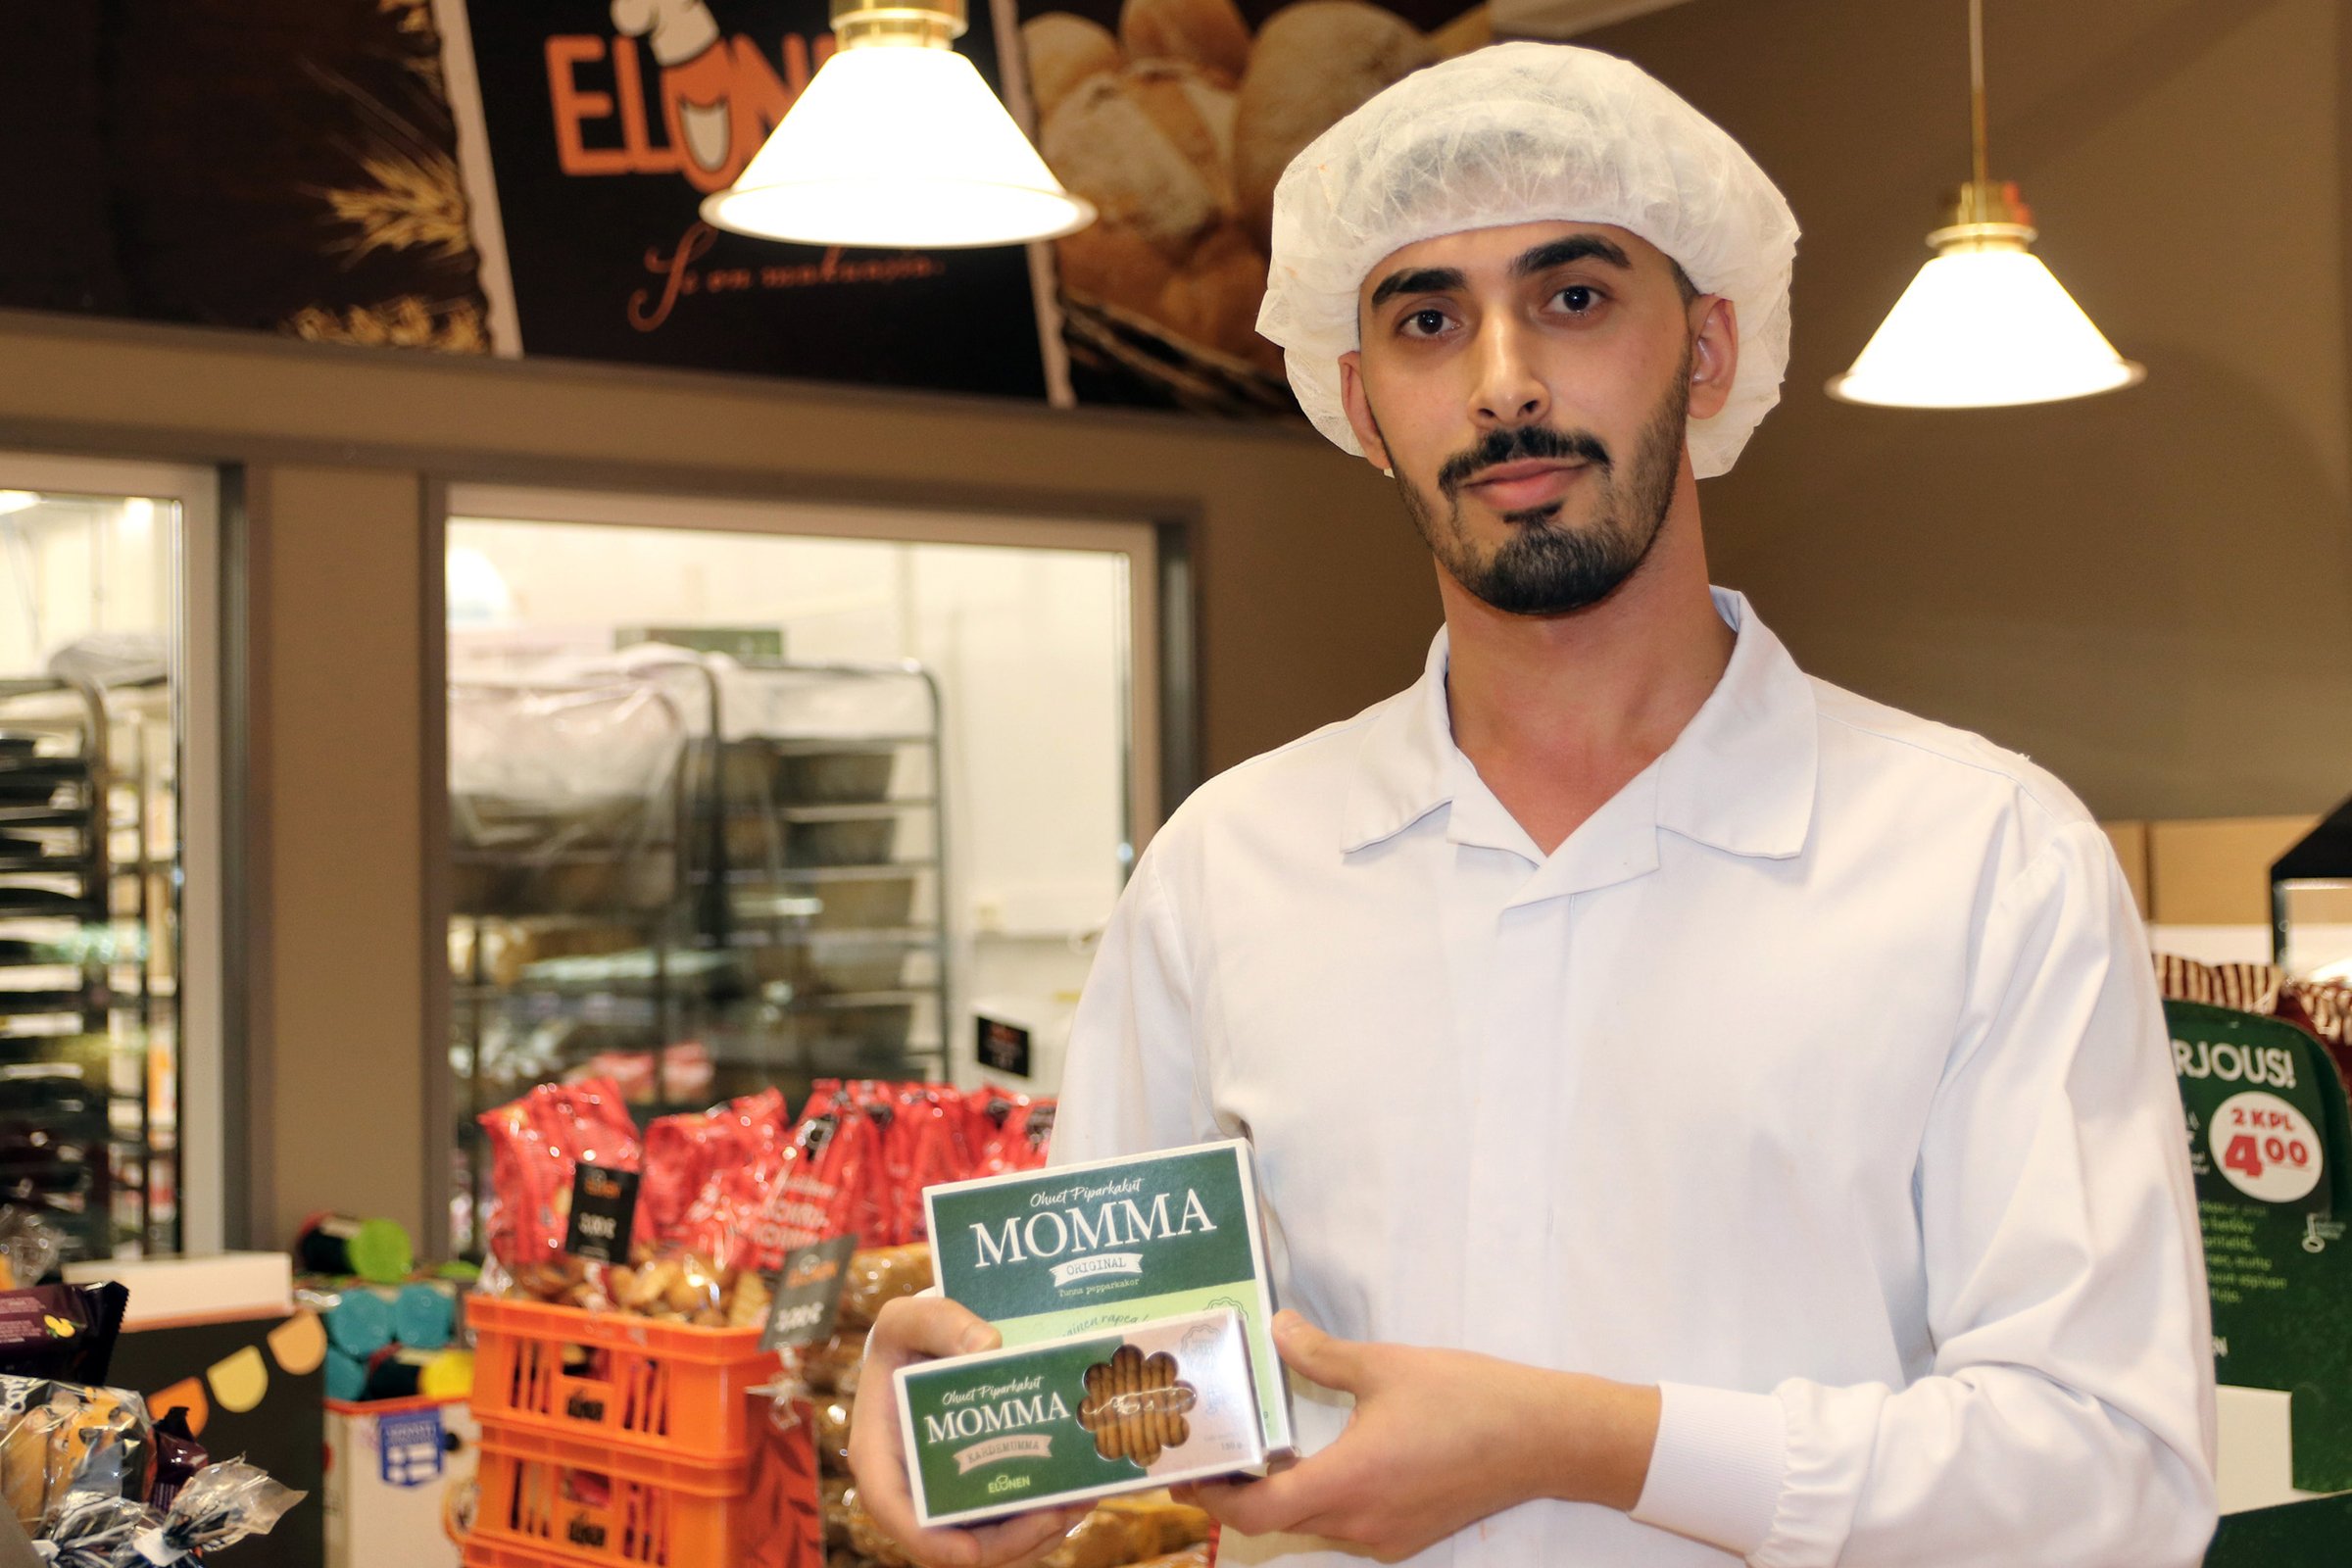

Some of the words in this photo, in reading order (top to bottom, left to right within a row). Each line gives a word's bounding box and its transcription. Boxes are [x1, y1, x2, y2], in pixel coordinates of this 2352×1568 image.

[544, 33, 837, 194] ELON
[2231, 1108, 2244, 1126] 2
[1030, 1190, 1068, 1207] Ohuet
[1068, 1178, 1145, 1202] Piparkakut
[969, 1188, 1217, 1268] MOMMA
[1066, 1257, 1127, 1275] ORIGINAL
[1086, 1278, 1141, 1296] pepparkakor
[942, 1390, 977, 1405] Ohuet
[977, 1376, 1045, 1399] Piparkakut
[924, 1391, 1071, 1444] MOMMA
[967, 1441, 1041, 1464] KARDEMUMMA
[988, 1475, 1031, 1494] ELONEN
